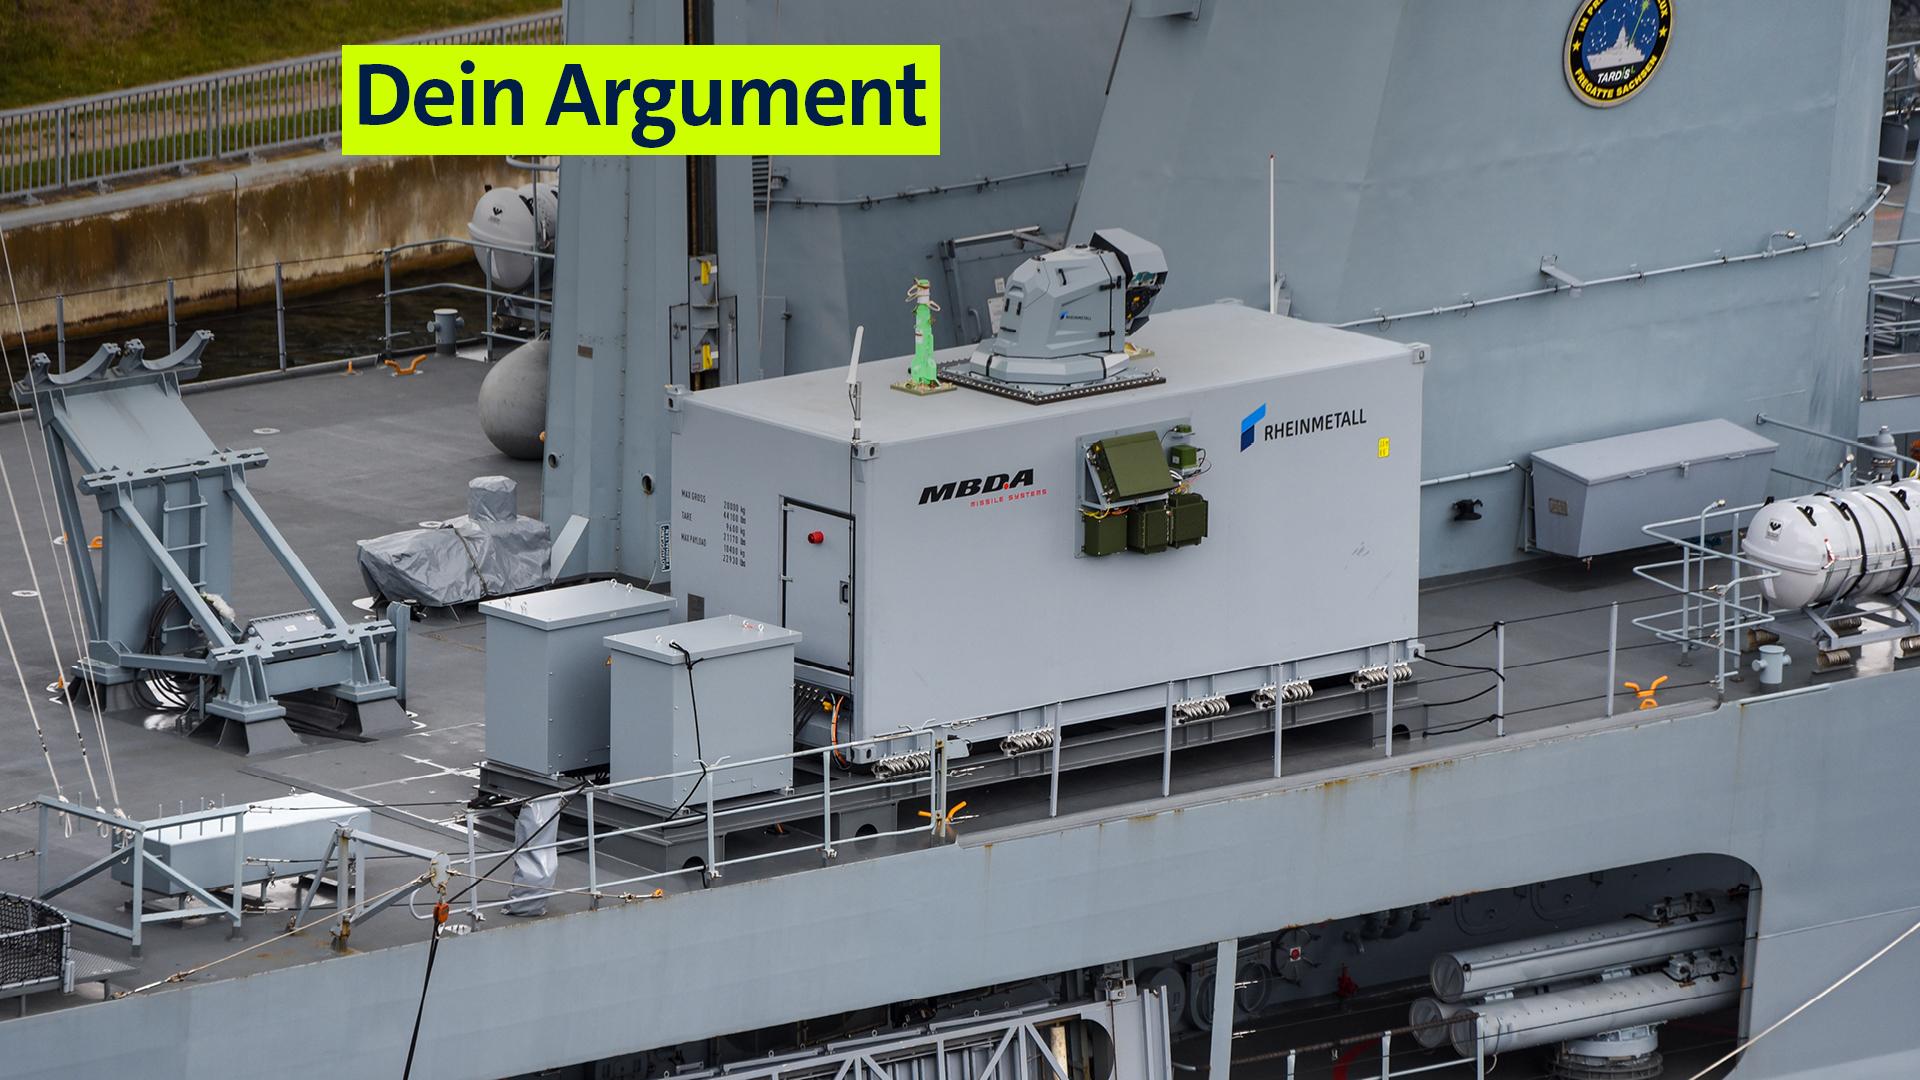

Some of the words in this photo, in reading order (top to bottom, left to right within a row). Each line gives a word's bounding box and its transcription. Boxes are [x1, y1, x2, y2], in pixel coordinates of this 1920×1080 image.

[1575, 67, 1615, 99] FREGATTE
[1616, 55, 1658, 97] SACHSEN
[1264, 408, 1367, 441] RHEINMETALL
[681, 489, 691, 499] MAX
[691, 491, 706, 504] GROSS
[918, 468, 1034, 505] MBDA
[970, 496, 1004, 508] MISSILE
[1008, 488, 1047, 501] SYSTEMS
[681, 511, 692, 521] TARE
[690, 535, 707, 547] PAYLOAD
